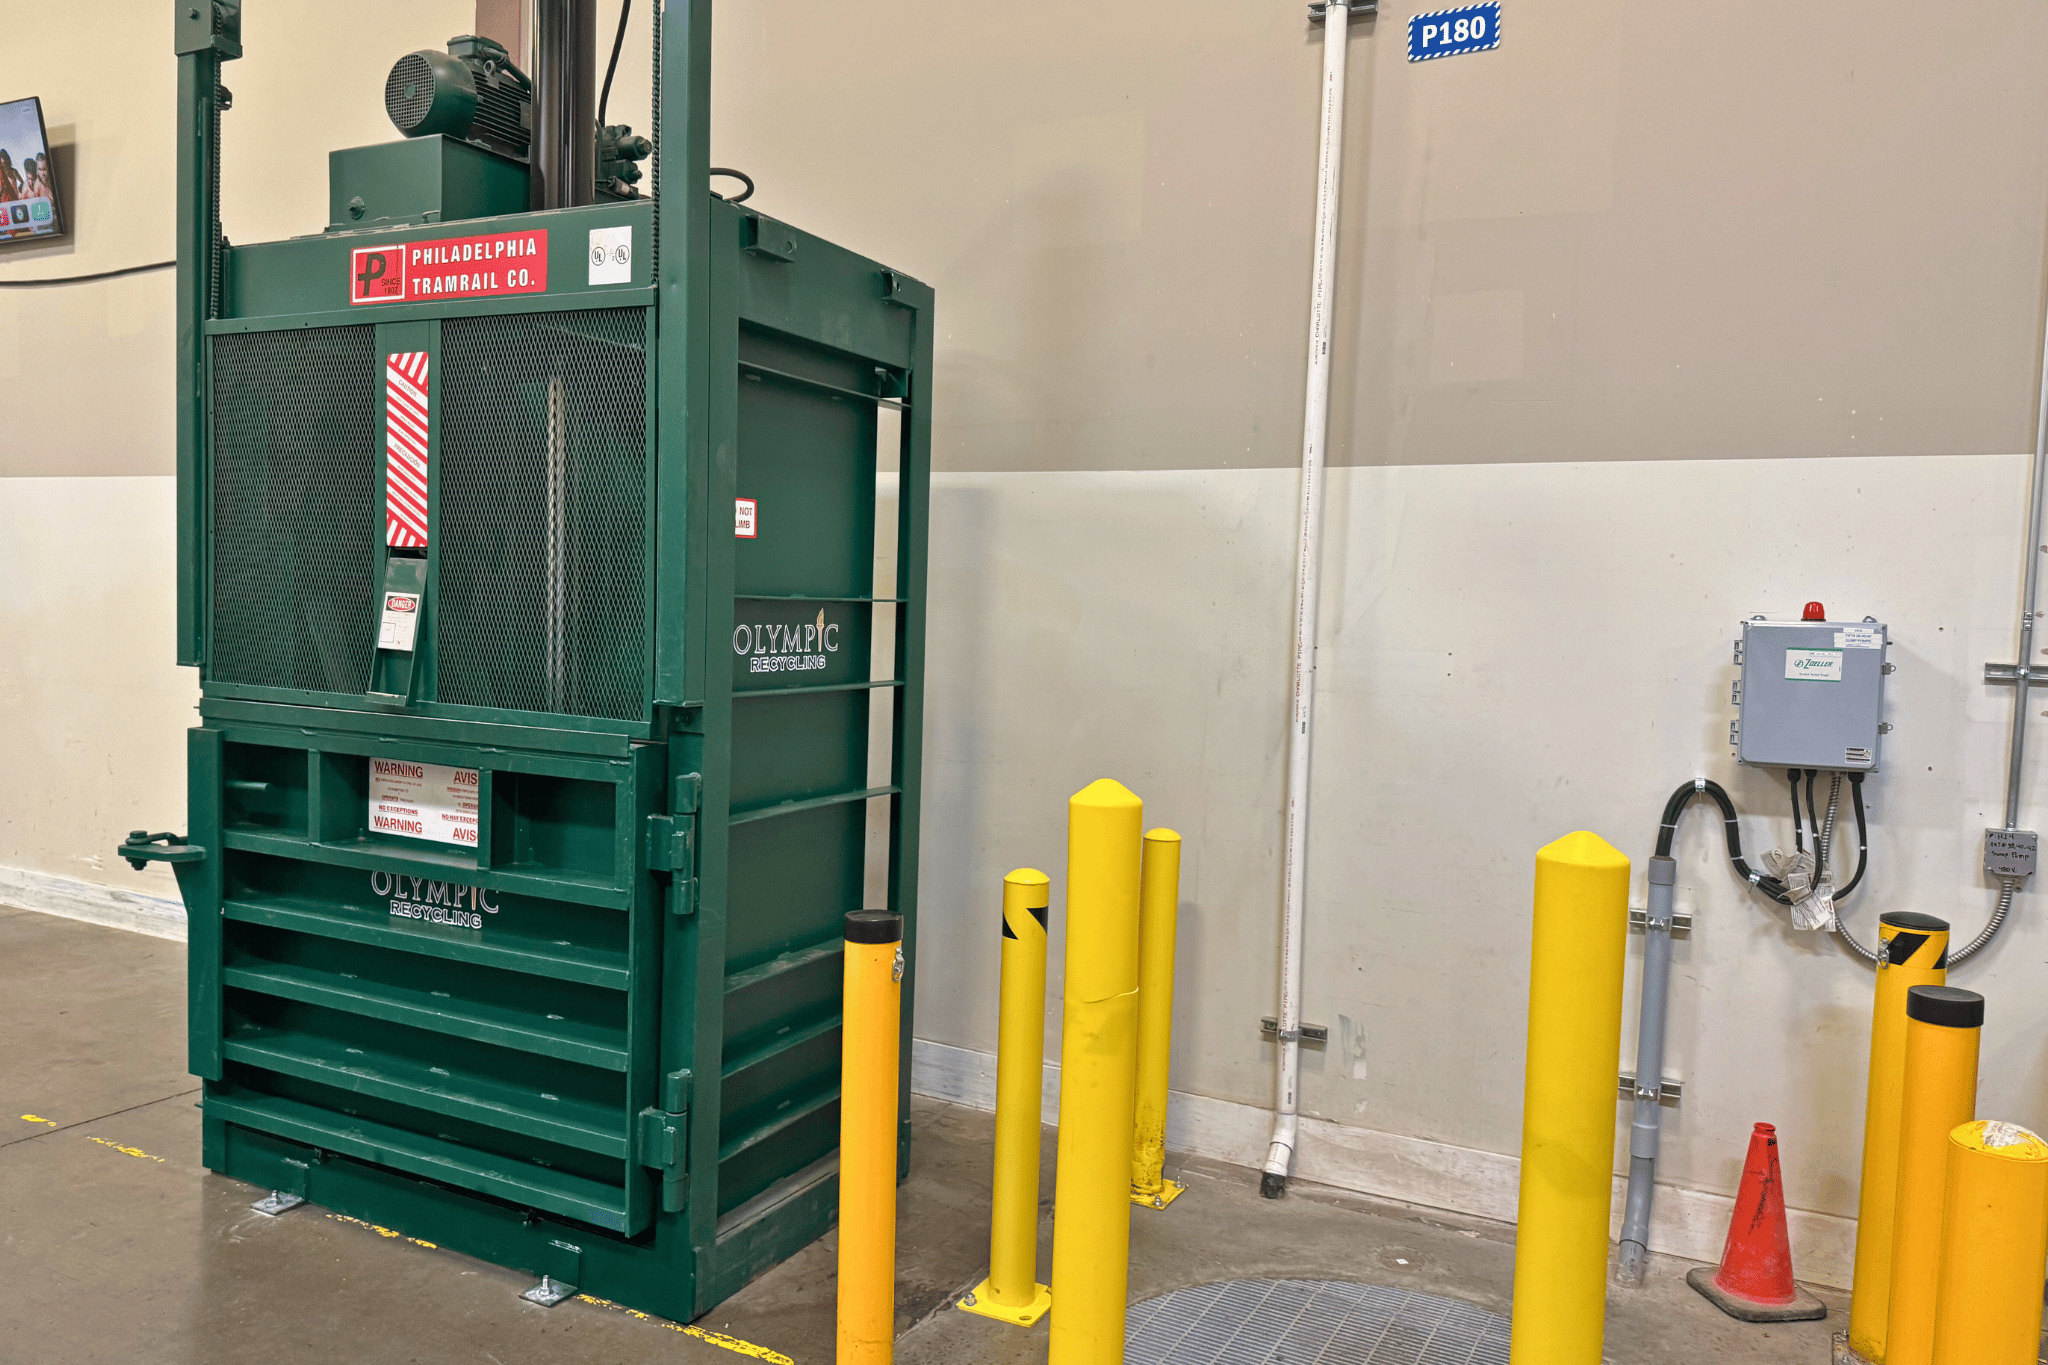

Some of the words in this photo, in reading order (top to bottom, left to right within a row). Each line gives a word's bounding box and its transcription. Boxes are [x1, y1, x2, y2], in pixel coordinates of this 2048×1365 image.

[1422, 15, 1486, 48] P180
[412, 238, 537, 266] PHILADELPHIA
[381, 277, 401, 287] SINCE
[412, 275, 499, 296] TRAMRAIL
[507, 269, 535, 288] CO.
[398, 379, 418, 397] CAUTION
[739, 506, 753, 516] NOT
[391, 599, 411, 609] DANGER
[733, 607, 839, 655] OLYMPIC
[750, 655, 826, 673] RECYCLING
[374, 760, 424, 778] WARNING
[387, 806, 418, 815] EXCEPTIONS
[374, 815, 423, 833] WARNING
[453, 827, 478, 842] AVIS
[371, 870, 499, 914] OLYMPIC
[389, 900, 483, 929] RECYCLING
